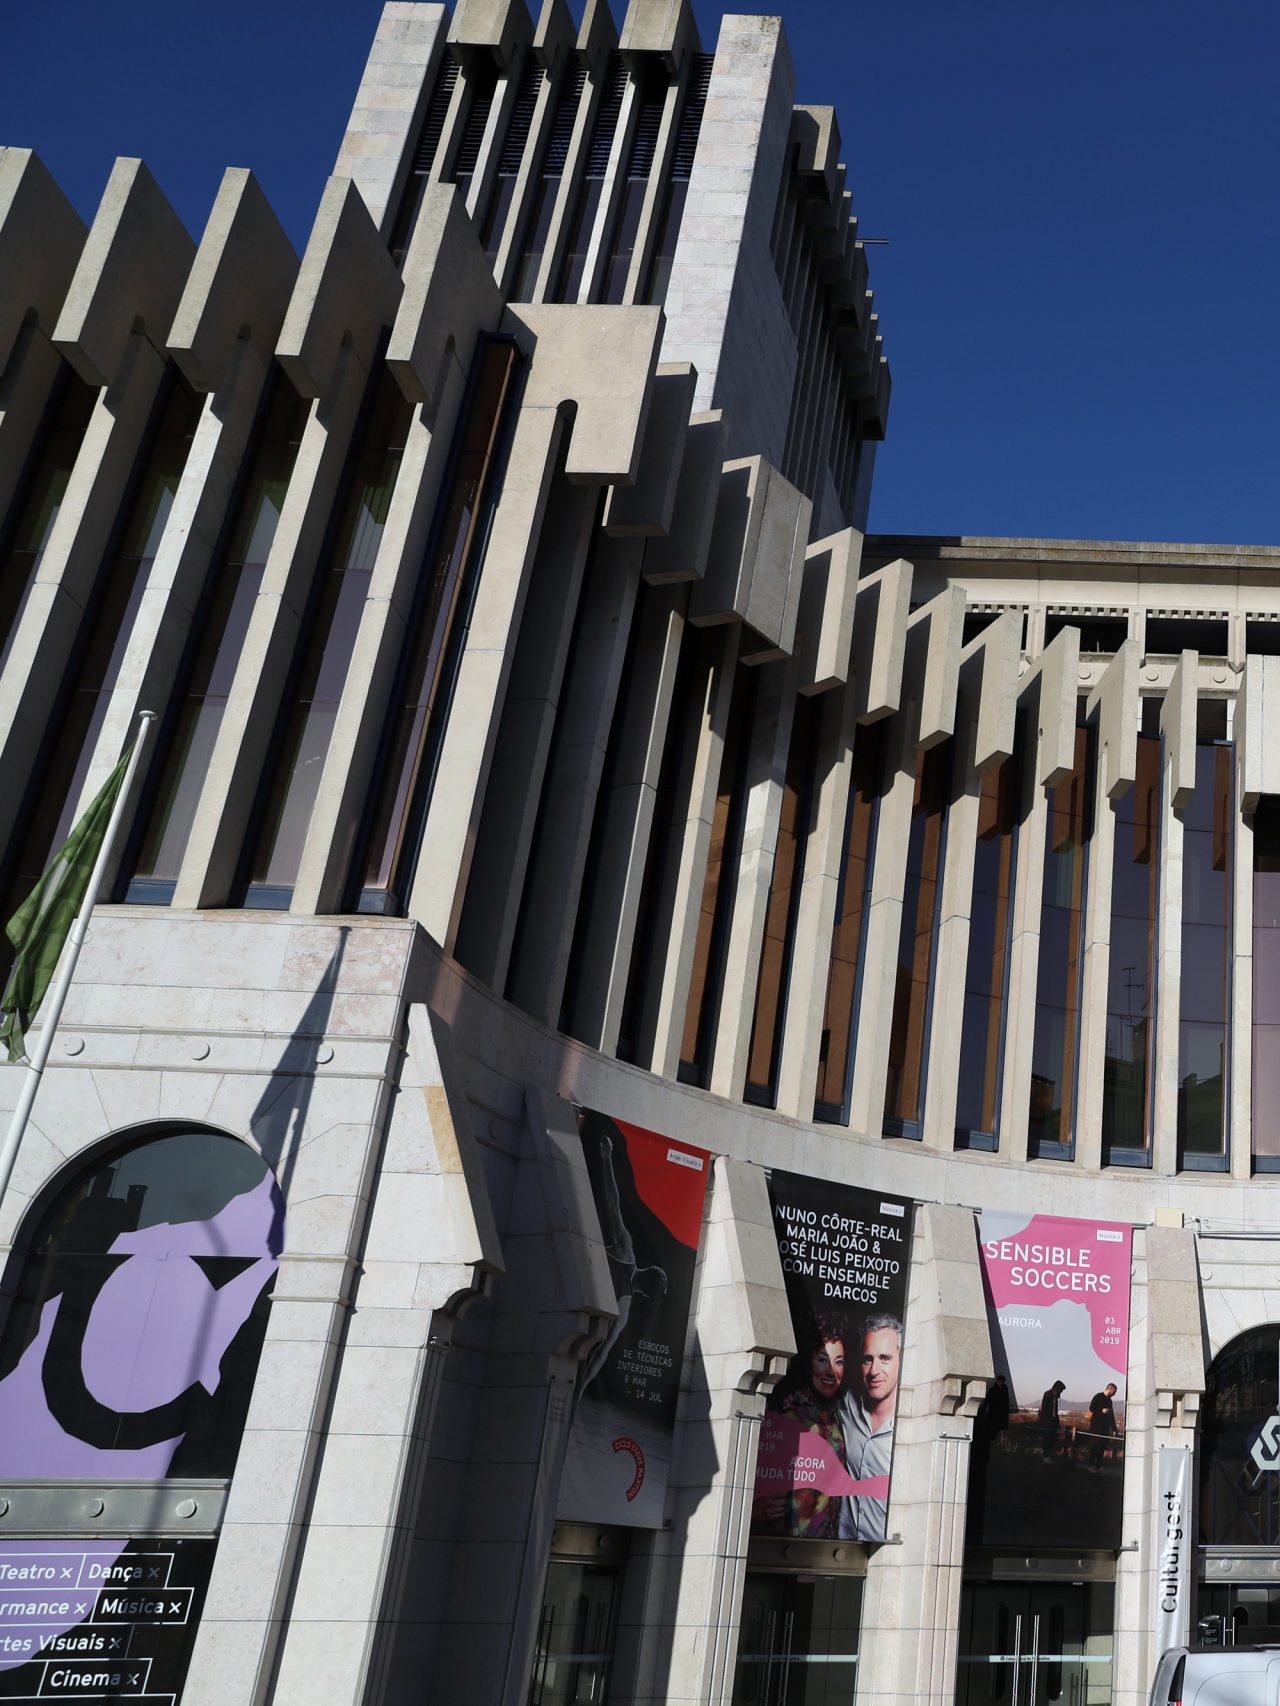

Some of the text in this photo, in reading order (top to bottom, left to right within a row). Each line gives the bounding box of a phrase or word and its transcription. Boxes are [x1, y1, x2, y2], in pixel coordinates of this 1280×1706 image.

[775, 1203, 903, 1242] NUNO CÔRTE-REAL
[786, 1224, 881, 1254] MARIA JOÃO &
[810, 1246, 840, 1264] LUIS
[845, 1254, 900, 1274] PEIXOTO
[985, 1240, 1091, 1268] SENSIBLE
[783, 1258, 890, 1290] COM ENSEMBLE
[1010, 1266, 1111, 1293] SOCCERS
[824, 1283, 878, 1304] DARCOS
[998, 1316, 1042, 1329] AURORA
[1104, 1316, 1115, 1325] 03
[1105, 1327, 1121, 1335] ABR
[639, 1340, 669, 1354] ESBOÇOS
[1100, 1336, 1120, 1345] 2019
[623, 1349, 672, 1367] DE TÉCNICAS
[617, 1361, 662, 1377] INTERIORES
[624, 1374, 647, 1387] 9 MAR
[636, 1389, 645, 1399] 14
[649, 1392, 662, 1402] JUL
[766, 1431, 784, 1440] MAR
[789, 1457, 825, 1470] AGORA
[787, 1469, 816, 1482] TUDO
[1160, 1491, 1183, 1613] Culturgest
[0, 1564, 55, 1579] Teatro
[89, 1564, 143, 1582] Dança
[101, 1598, 163, 1614] Música
[39, 1634, 105, 1651] Visuais
[51, 1670, 120, 1687] Cinema
